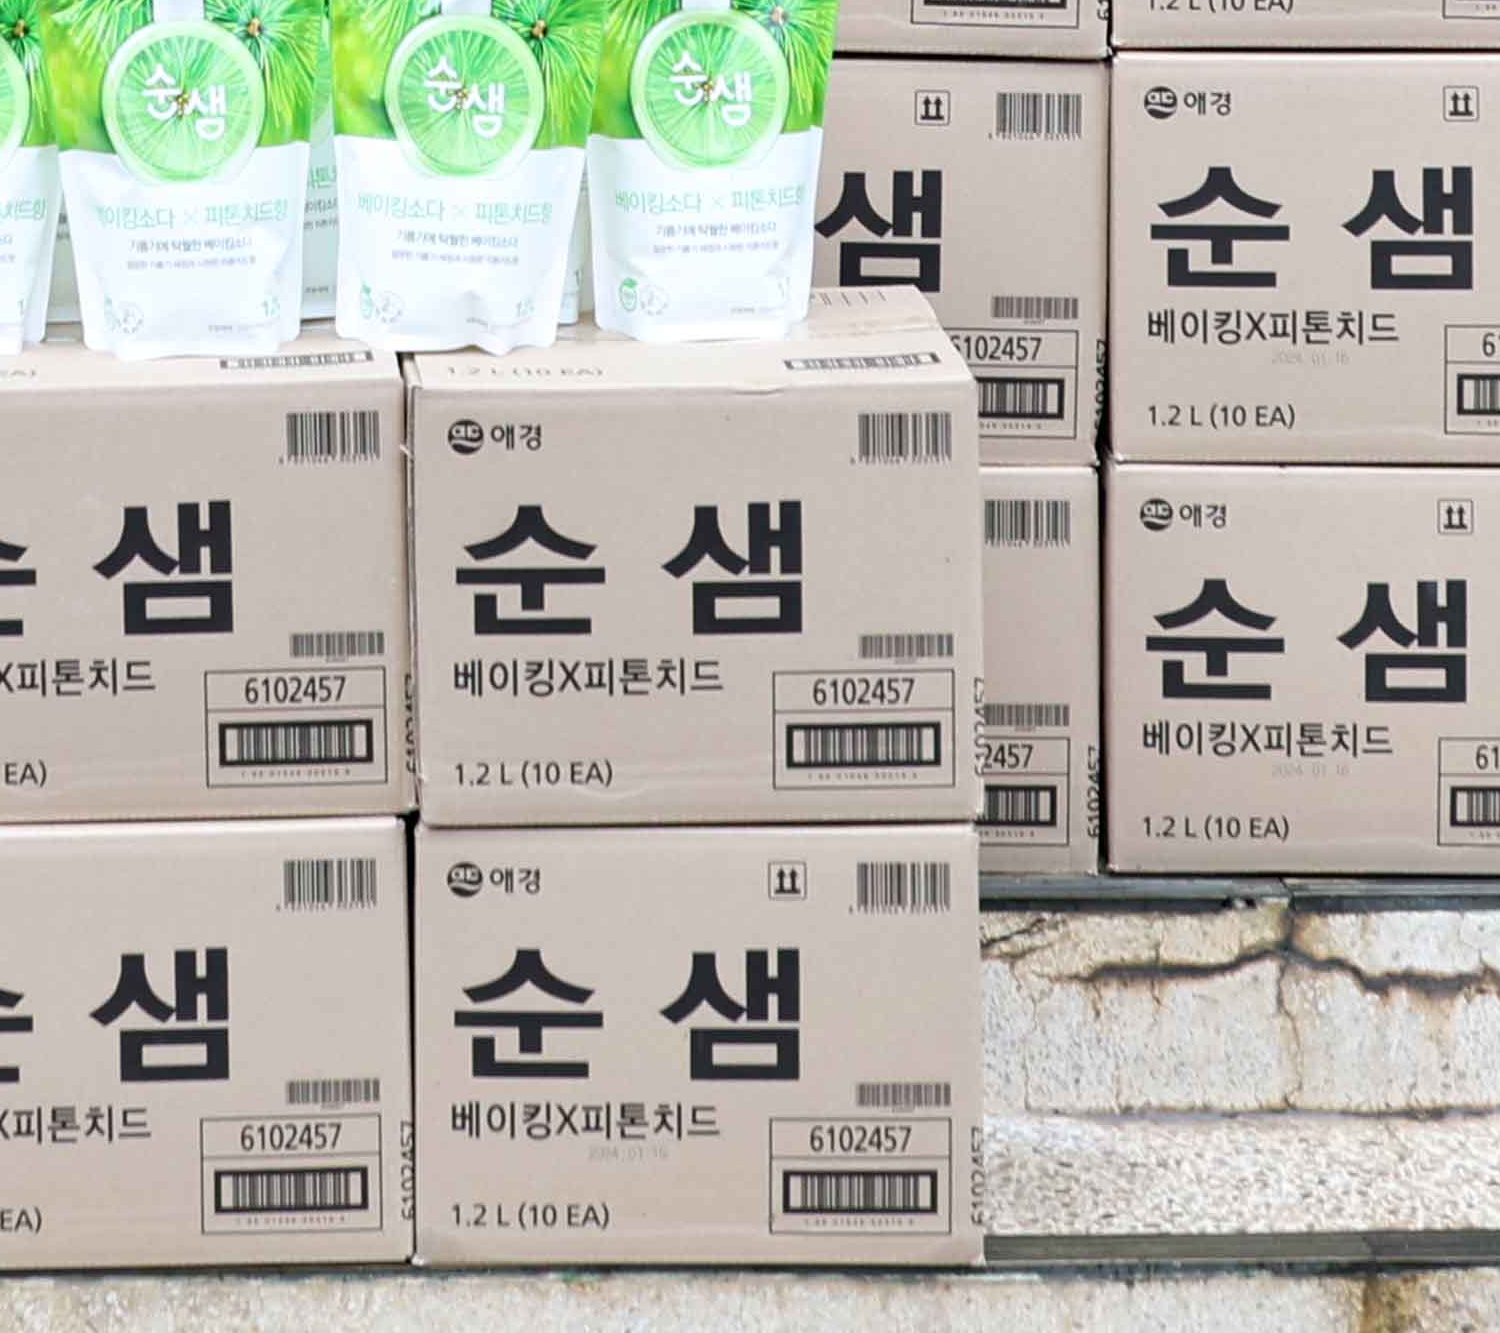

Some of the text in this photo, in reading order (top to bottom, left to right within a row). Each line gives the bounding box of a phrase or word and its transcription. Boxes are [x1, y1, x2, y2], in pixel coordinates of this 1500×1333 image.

[1183, 92, 1231, 117] 애경
[1150, 166, 1473, 290] 순 샘
[1148, 308, 1399, 346] 베이킹X피톤치드
[490, 424, 542, 451] 애경
[93, 500, 233, 635] 샘
[455, 500, 802, 636] 순 샘
[1145, 578, 1467, 703] 순 샘
[245, 676, 346, 704] 6102457
[454, 658, 723, 697] 베이킹X피톤치드
[813, 678, 915, 706] 6102457
[1143, 720, 1393, 758] 베이킹X피톤치드
[489, 868, 541, 894] 애경
[90, 947, 230, 1082] 샘
[453, 948, 800, 1080] 순 샘
[240, 1123, 341, 1151] 6102457
[451, 1101, 719, 1140] 베이킹X피톤치드
[810, 1126, 912, 1152] 6102457
